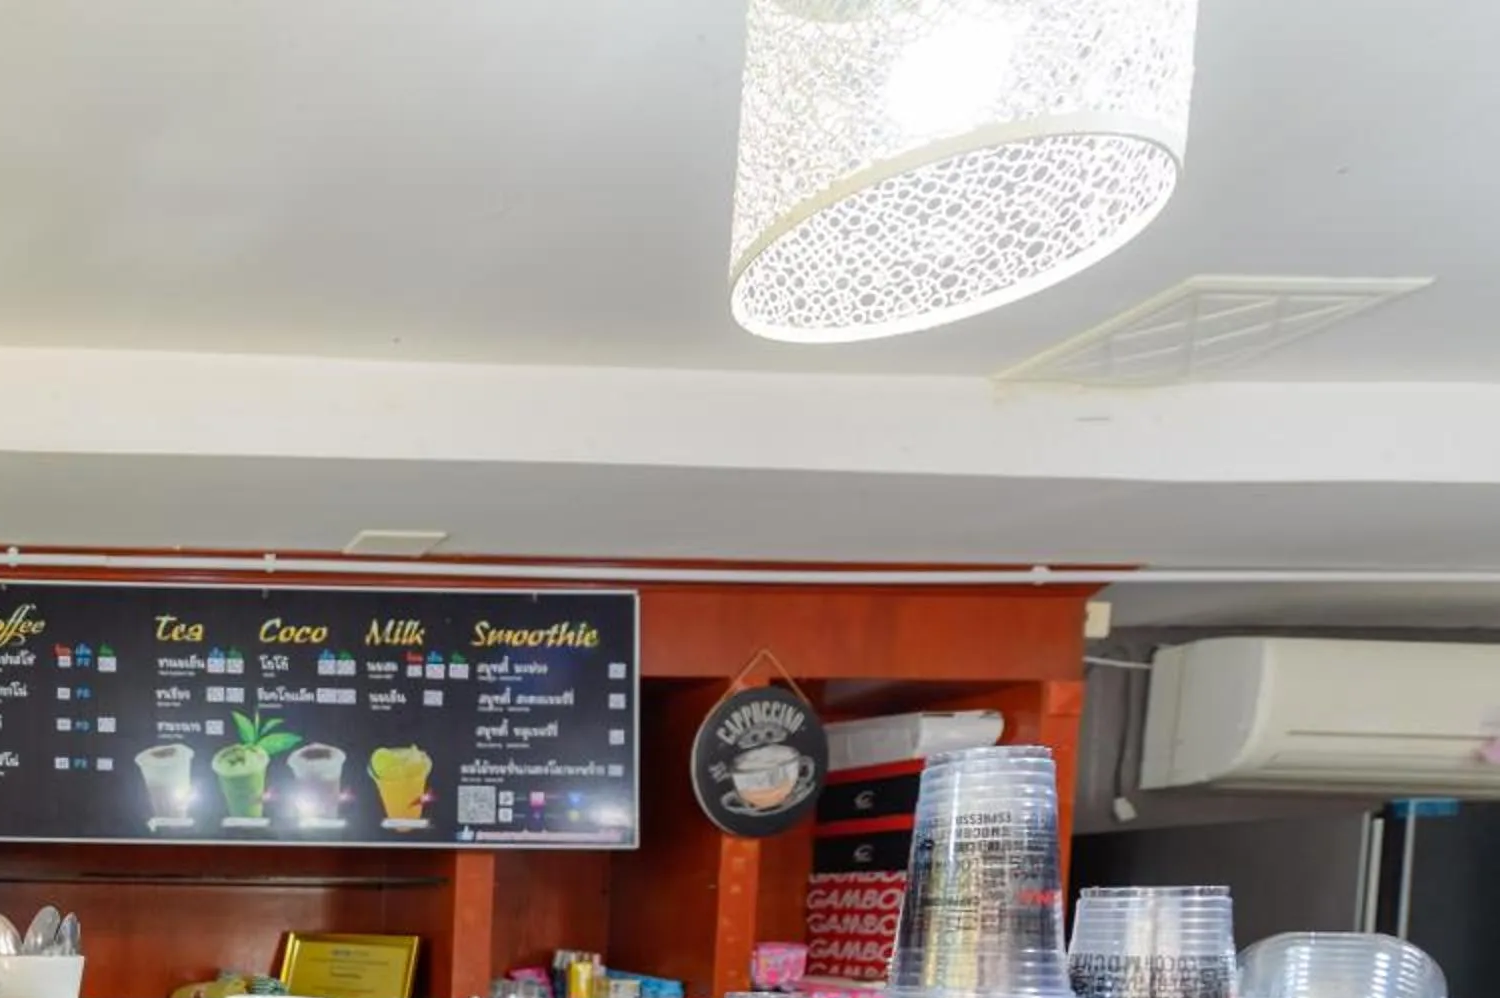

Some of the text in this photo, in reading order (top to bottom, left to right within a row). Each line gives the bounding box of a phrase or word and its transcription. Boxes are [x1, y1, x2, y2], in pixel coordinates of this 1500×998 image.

[154, 614, 205, 642] Tea
[259, 616, 328, 644] Coco
[365, 617, 425, 646] Milk
[471, 620, 599, 648] Smoothie
[716, 701, 805, 745] CAPPUCCINO
